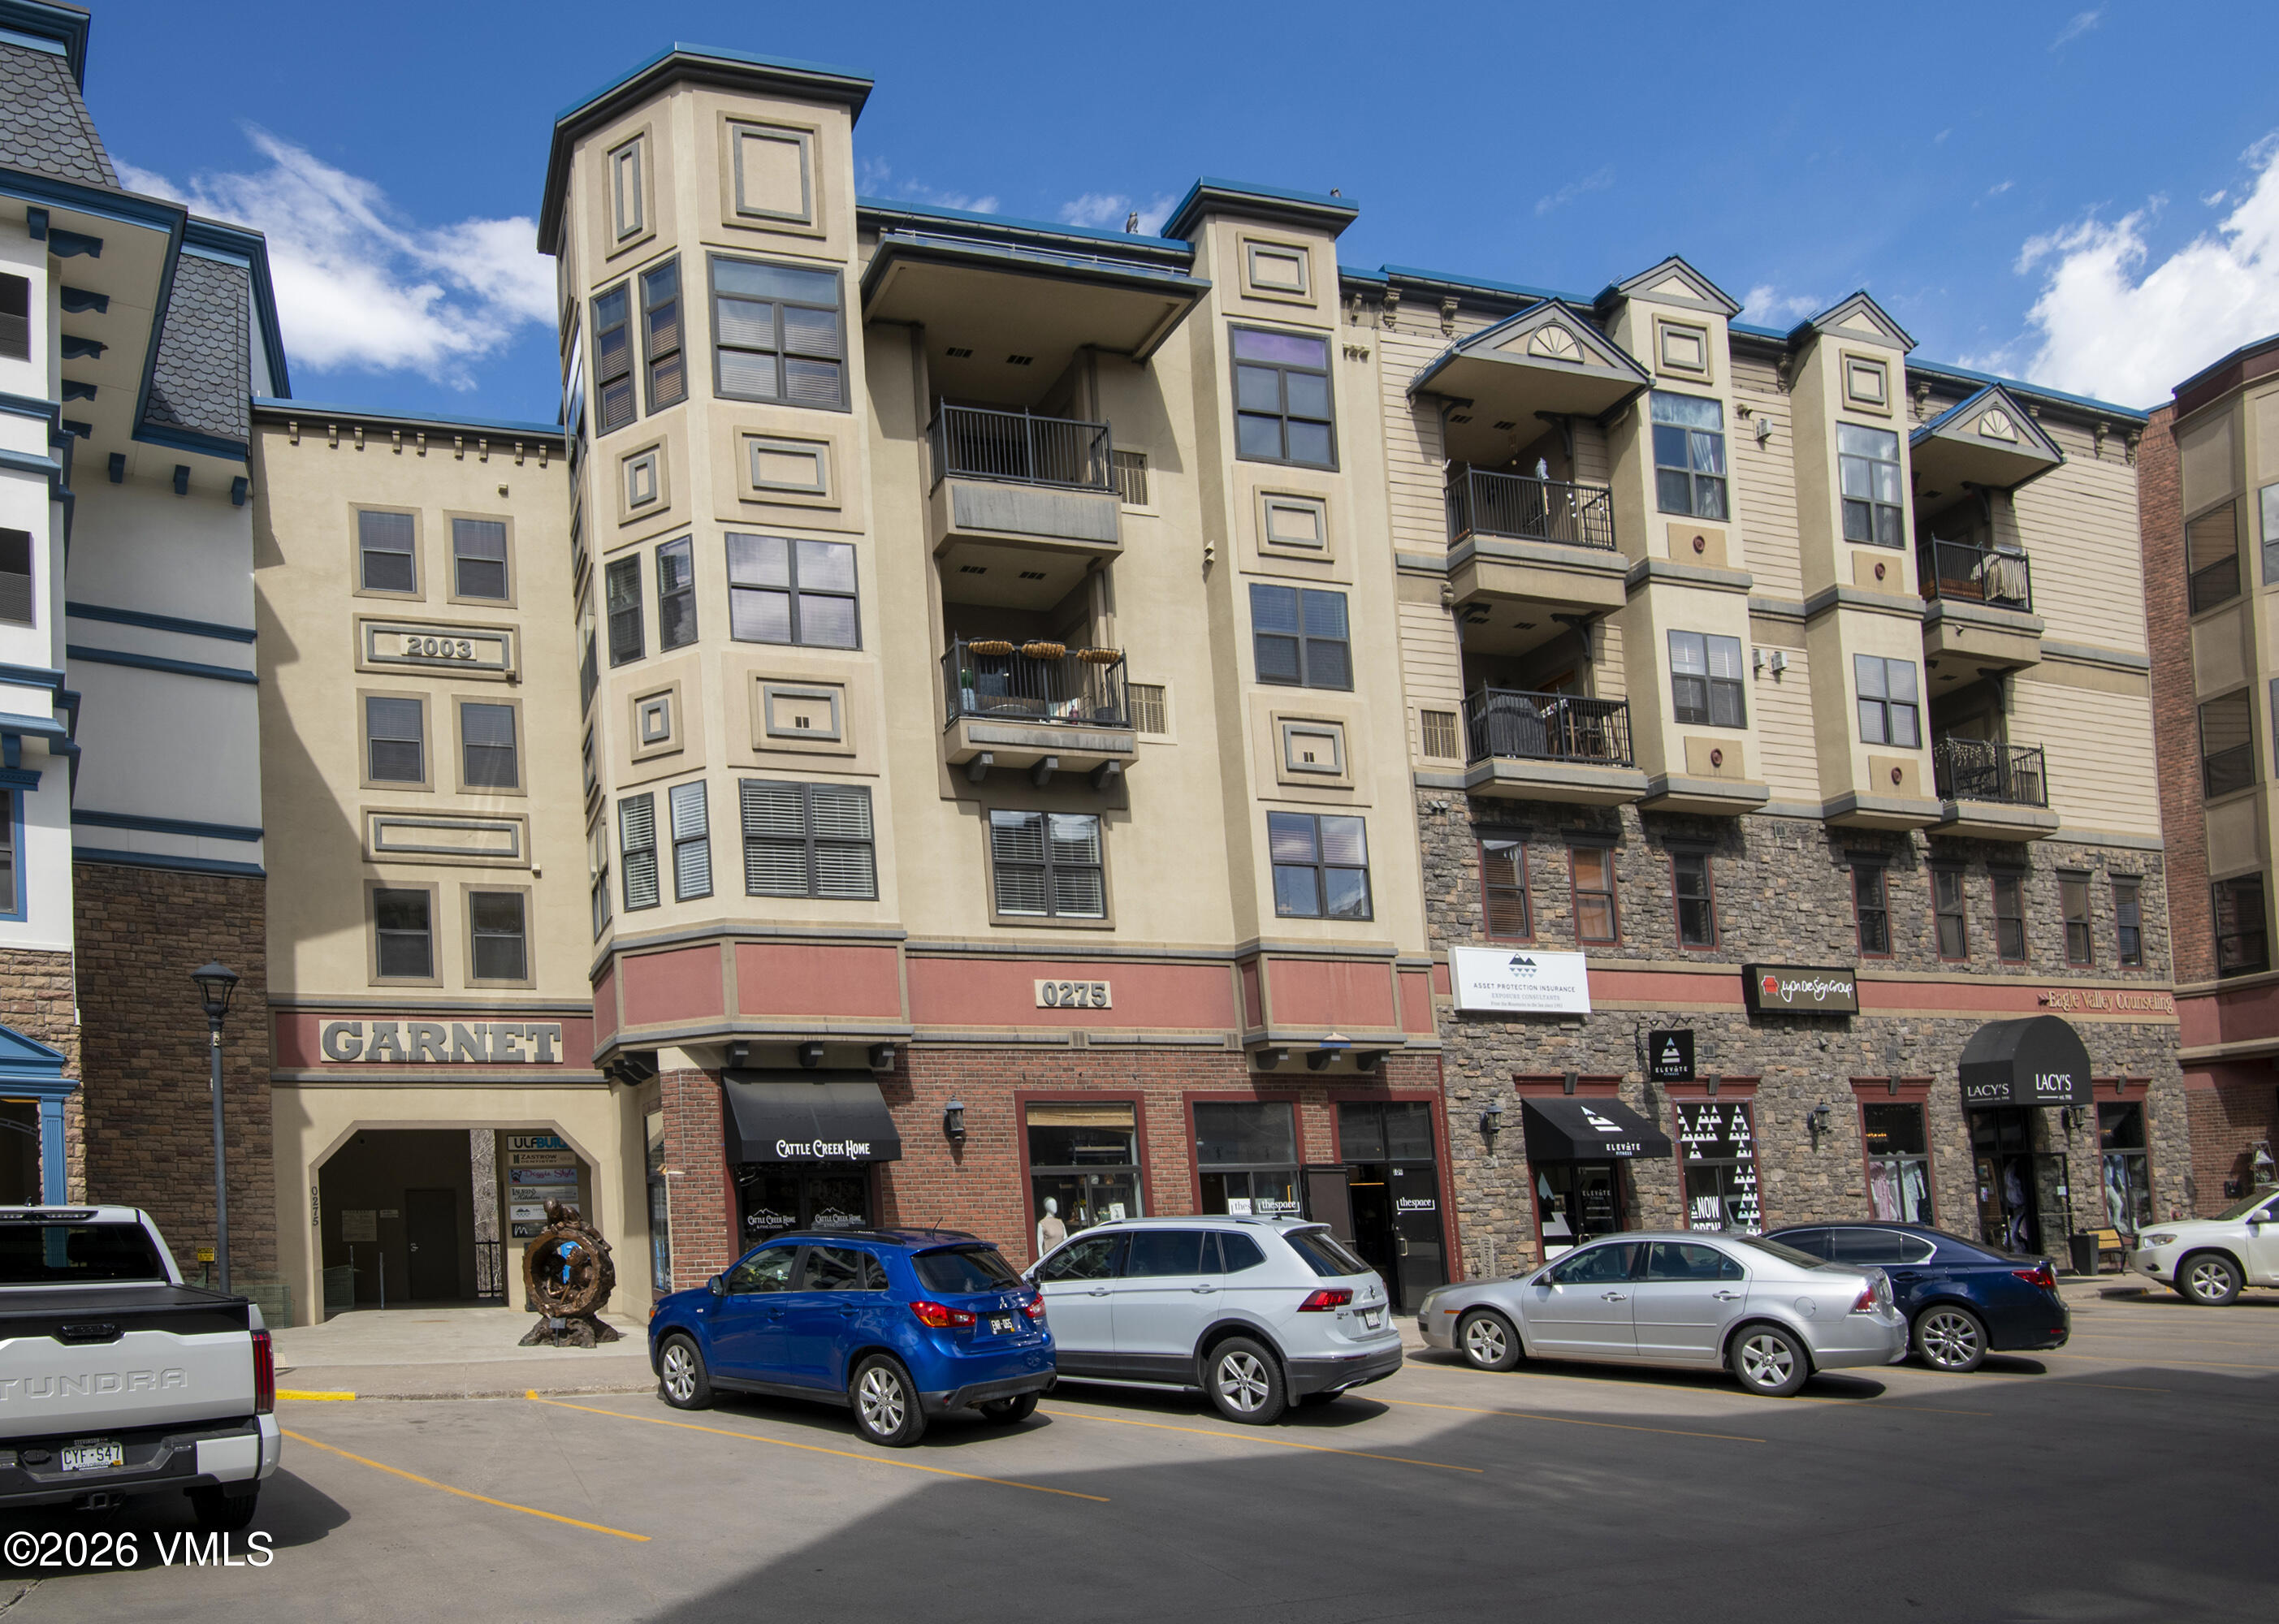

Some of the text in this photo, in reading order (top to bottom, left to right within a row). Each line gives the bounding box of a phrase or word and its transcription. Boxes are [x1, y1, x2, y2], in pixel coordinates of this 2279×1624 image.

[407, 637, 472, 659] 2003
[1042, 982, 1107, 1007] 0275
[1539, 985, 1576, 993] INSURANCE
[2048, 991, 2173, 1013] Eagle Valley Counseling
[322, 1021, 561, 1063] GARNET
[1967, 1083, 2009, 1097] LACY'S
[2035, 1073, 2072, 1091] LACY'S
[514, 1137, 568, 1148] ULFBUIL
[776, 1139, 871, 1160] CATTLE CREEK HOME
[1606, 1142, 1641, 1151] ELEVATE
[1261, 1199, 1296, 1211] thespace
[1399, 1197, 1431, 1208] thespace
[1697, 1196, 1719, 1219] NOW
[0, 1367, 188, 1401] TUNDRA
